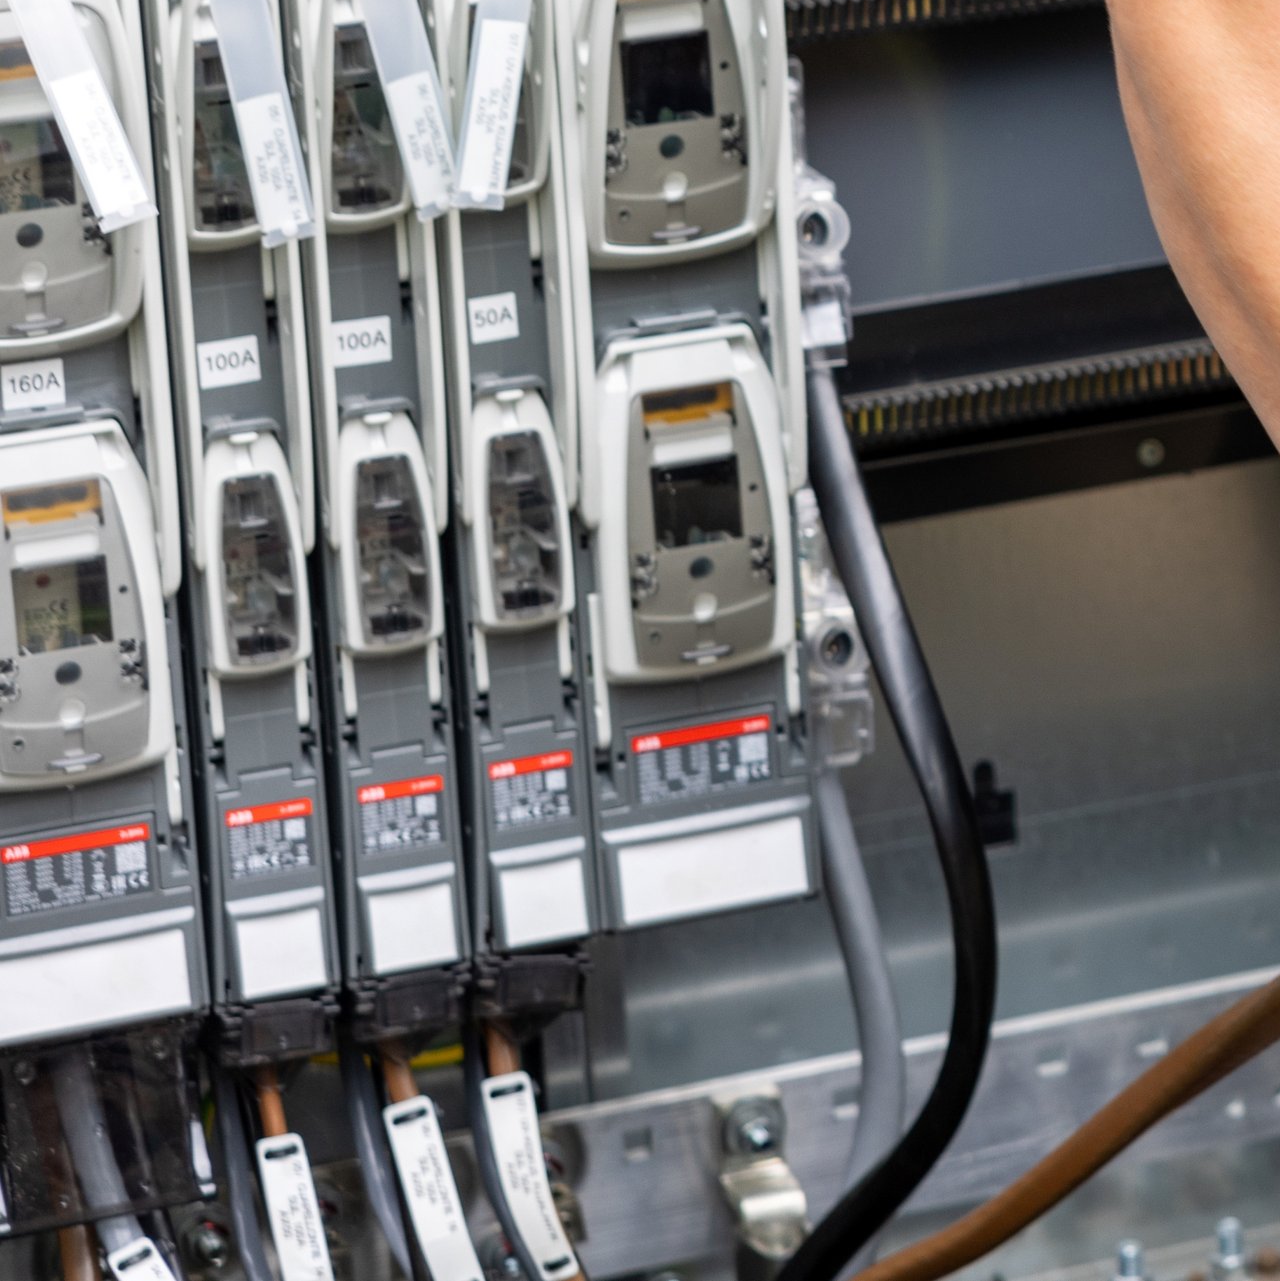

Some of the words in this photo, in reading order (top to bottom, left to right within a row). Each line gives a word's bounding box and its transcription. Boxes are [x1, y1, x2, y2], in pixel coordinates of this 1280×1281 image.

[475, 306, 513, 328] 50A
[338, 328, 388, 350] 100A
[205, 349, 256, 372] 100A
[9, 372, 61, 395] 160A
[5, 845, 30, 861] ABB
